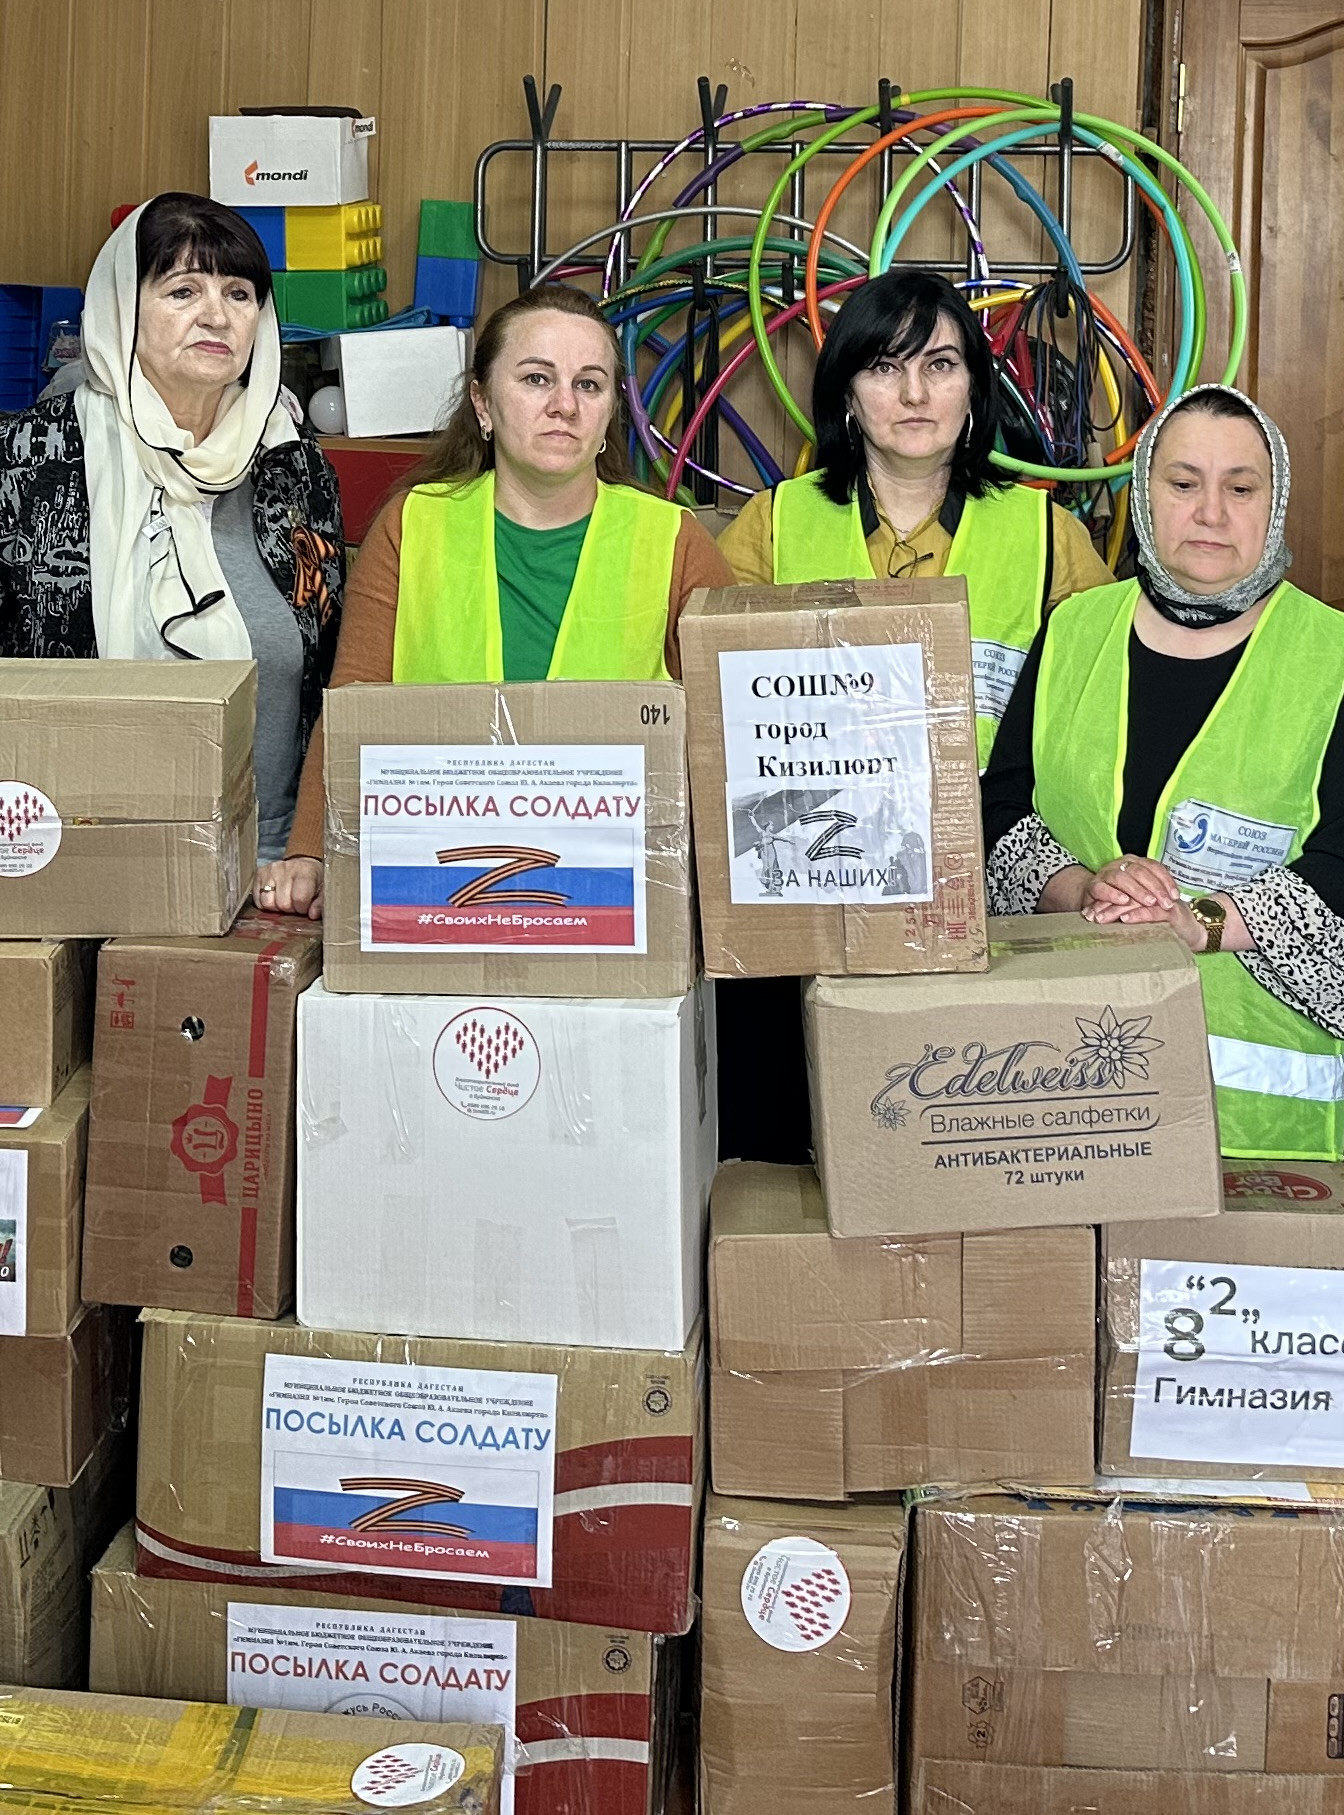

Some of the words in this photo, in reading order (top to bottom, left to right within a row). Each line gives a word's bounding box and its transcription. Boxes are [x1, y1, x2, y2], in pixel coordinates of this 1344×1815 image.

[355, 120, 374, 133] mondi
[256, 169, 308, 181] mondi
[972, 660, 996, 673] ТЕРЕЙ
[751, 671, 874, 698] СОШ№9
[640, 703, 671, 725] 140
[754, 721, 829, 747] город
[756, 755, 898, 778] Кизилюрт
[363, 795, 500, 817] ПОСЫЛКА
[509, 795, 641, 820] СОЛДАТУ
[1210, 832, 1250, 850] МАТЕРЕЙ
[1238, 825, 1268, 841] СОЮЗ
[772, 869, 800, 888] ЗА
[417, 913, 588, 928] #СвоихНеБросаем
[908, 1041, 1113, 1100] Edelweiss
[931, 1113, 1035, 1133] Влажные
[1042, 1106, 1150, 1131] салфетки
[242, 1088, 263, 1199] ЦАРИЦЫНО
[934, 1142, 1153, 1169] АНТИБАКТЕРИАЛЬНЫЕ
[1004, 1171, 1025, 1186] 72
[1030, 1170, 1085, 1186] штуки
[1163, 1307, 1205, 1361] 8
[1154, 1376, 1331, 1411] Гимназия
[265, 1408, 406, 1441] ПОСЫЛКА
[415, 1420, 552, 1450] СОЛДАТУ
[320, 1534, 490, 1559] #СвоихНеБросаем
[231, 1652, 370, 1681] ПОСЫЛКА
[379, 1662, 512, 1691] СОЛДАТУ
